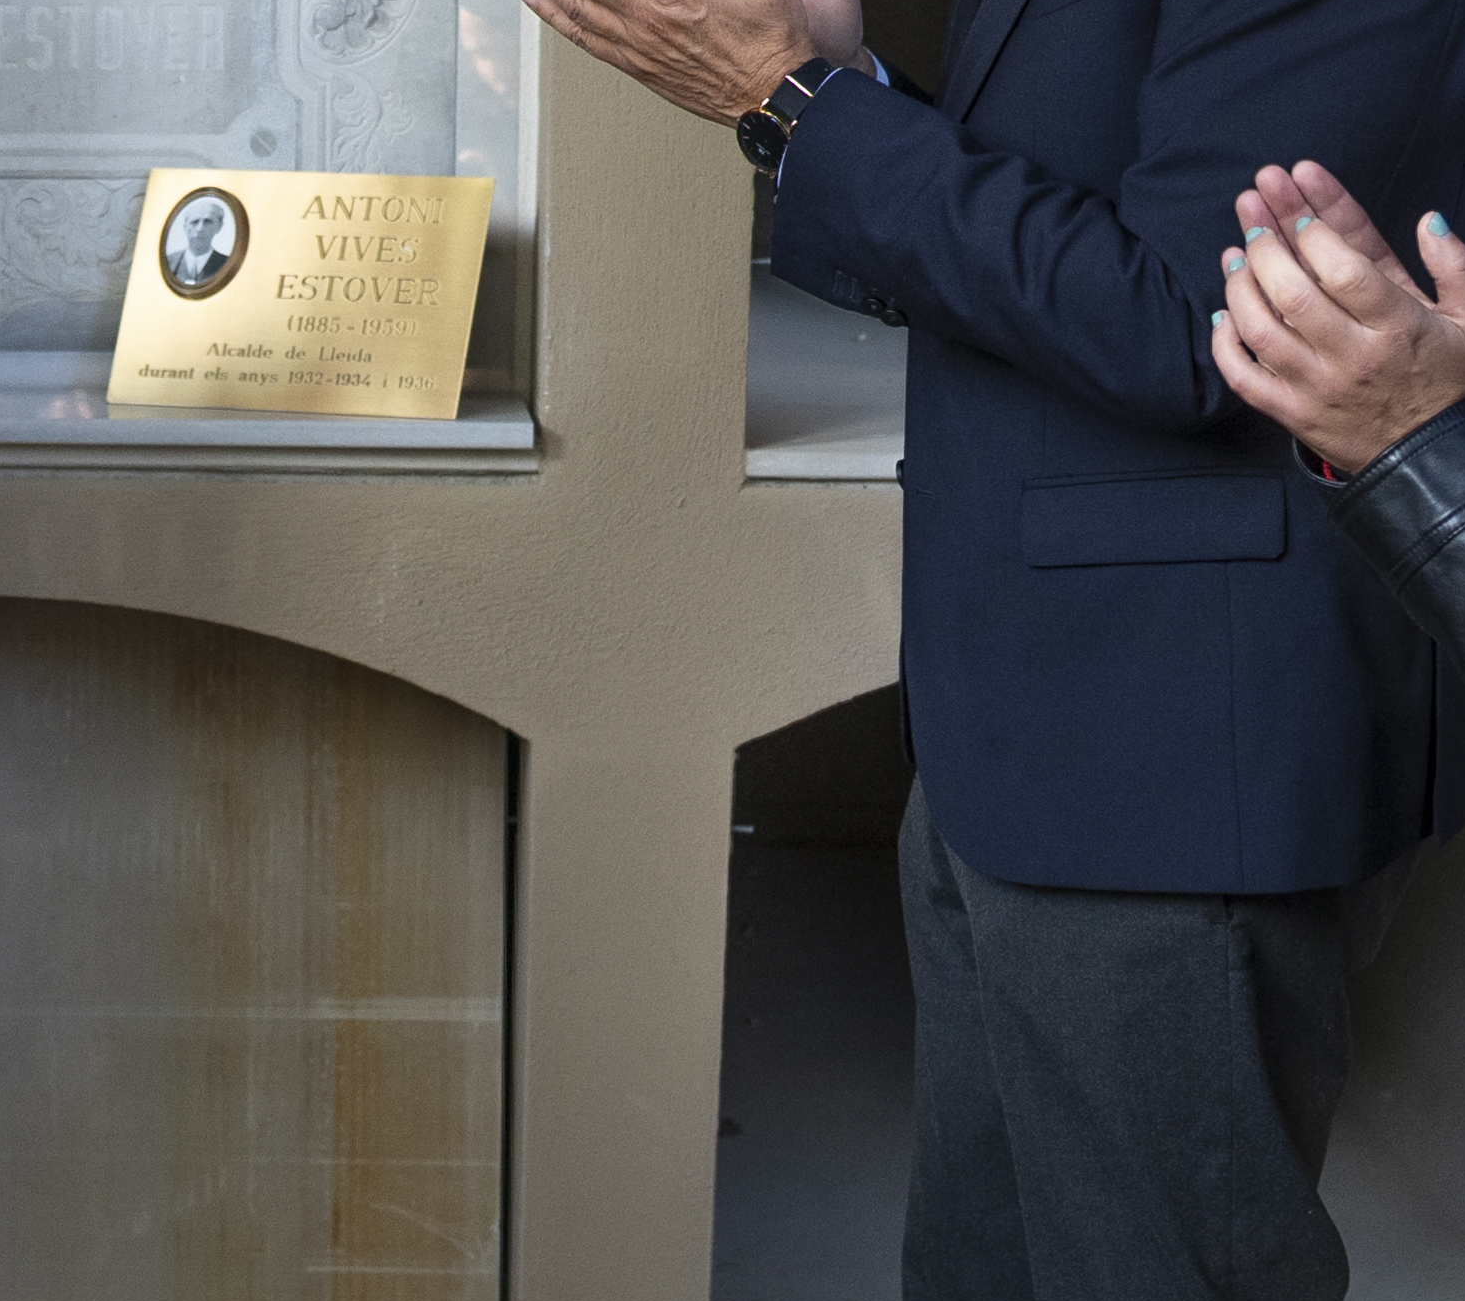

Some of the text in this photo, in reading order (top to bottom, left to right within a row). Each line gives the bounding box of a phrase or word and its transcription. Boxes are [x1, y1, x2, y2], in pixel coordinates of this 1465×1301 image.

[301, 195, 444, 224] ANTONI
[314, 234, 419, 263] VIVES
[274, 274, 440, 306] ESTOVER
[206, 342, 373, 364] Alcalde de Lleida
[137, 363, 194, 381] durant
[203, 366, 229, 382] els
[238, 371, 279, 386] anys
[287, 369, 371, 388] 1932-1934
[397, 375, 435, 390] 1936
